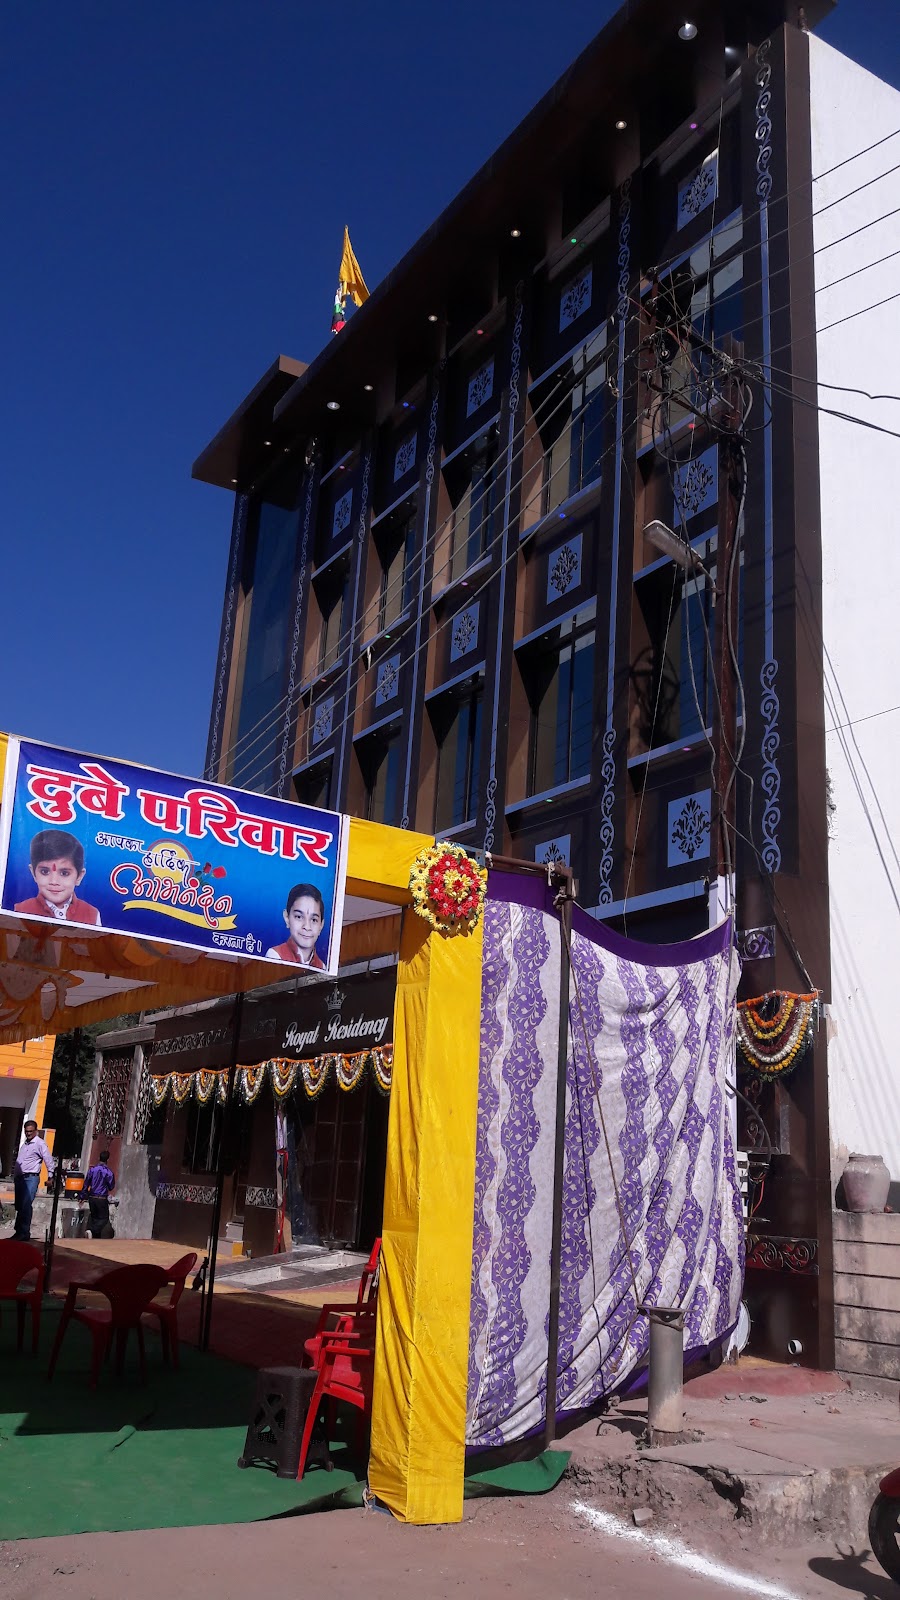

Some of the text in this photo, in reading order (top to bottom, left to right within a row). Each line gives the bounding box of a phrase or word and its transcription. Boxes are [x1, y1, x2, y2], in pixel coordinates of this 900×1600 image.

[26, 763, 332, 867] दुबे परिवार
[95, 832, 200, 888] आपका हार्दिक
[212, 931, 245, 949] करता
[282, 1013, 389, 1053] Royal Residency
